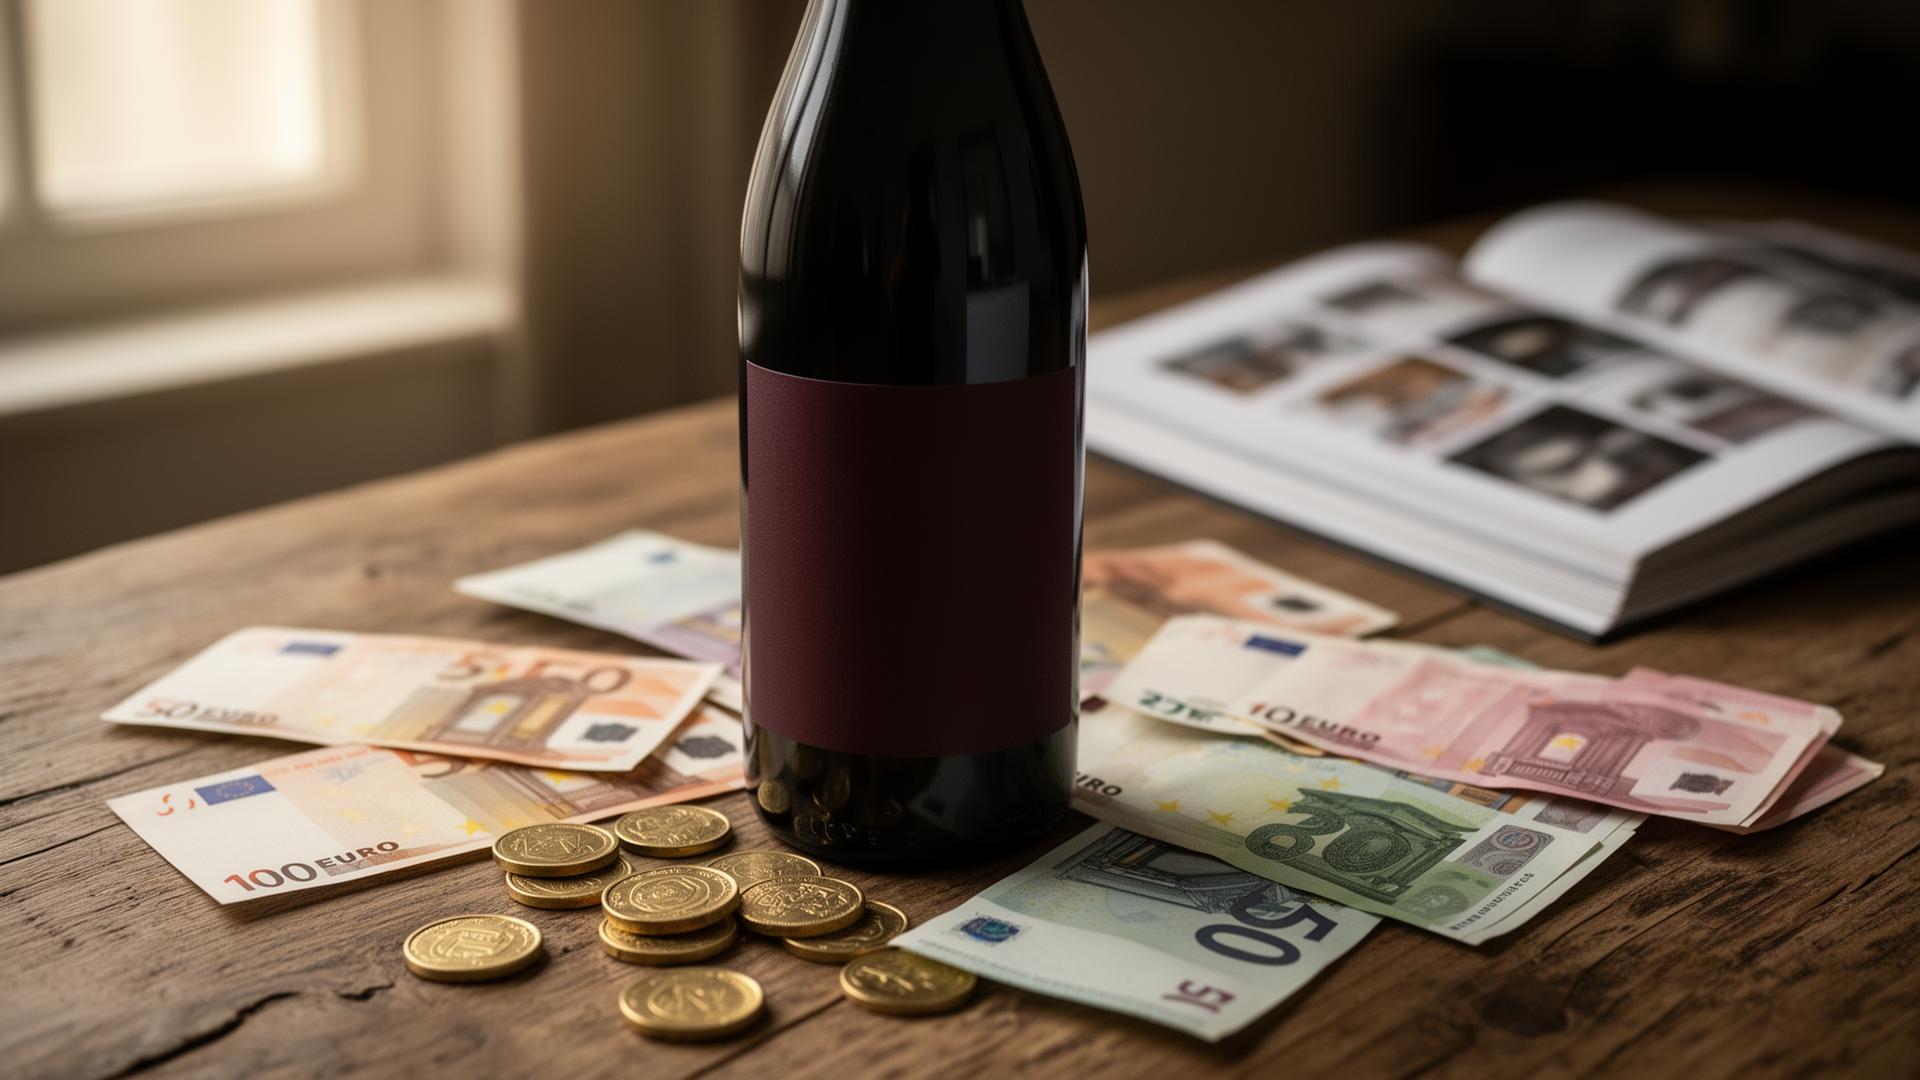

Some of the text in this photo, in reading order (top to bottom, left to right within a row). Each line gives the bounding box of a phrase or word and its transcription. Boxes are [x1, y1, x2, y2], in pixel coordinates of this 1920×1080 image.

[1249, 703, 1297, 725] 10
[1299, 714, 1382, 742] EURO
[223, 841, 400, 892] 100 EURO
[1195, 889, 1339, 966] 50
